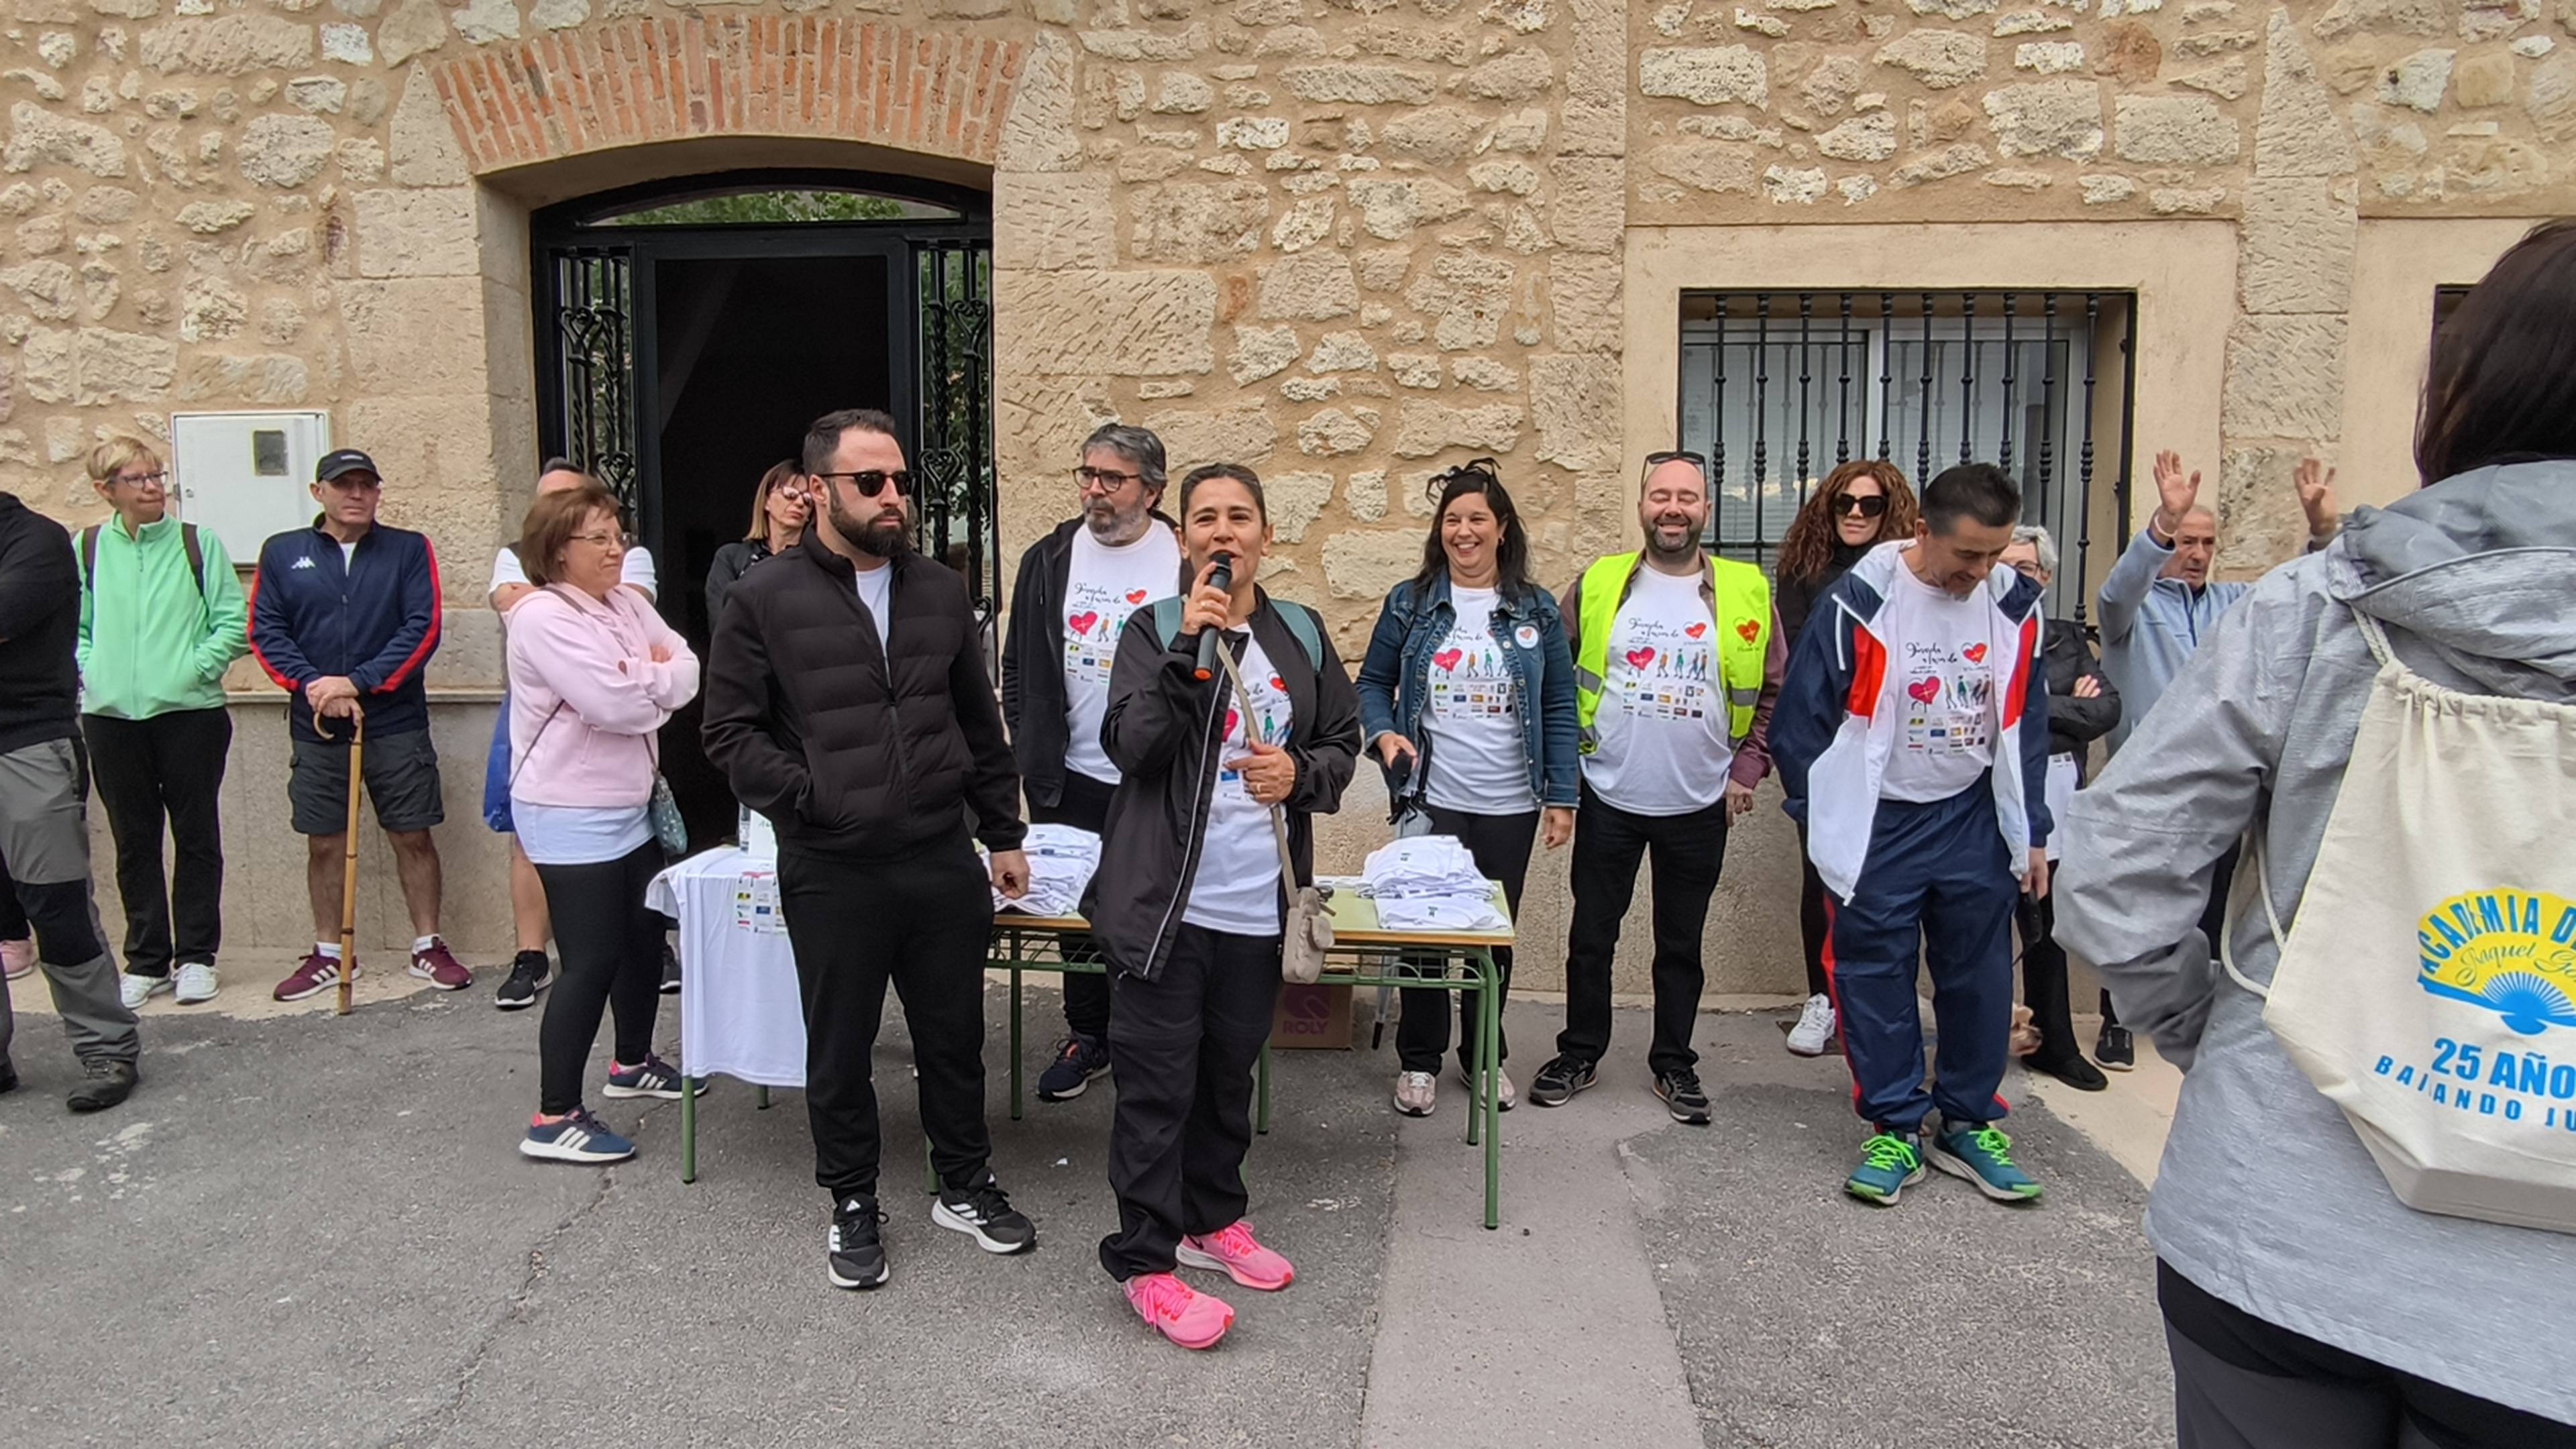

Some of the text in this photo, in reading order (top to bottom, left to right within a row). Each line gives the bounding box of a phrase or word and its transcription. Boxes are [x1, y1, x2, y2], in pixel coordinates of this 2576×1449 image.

[2550, 906, 2576, 951] D
[1283, 1020, 1328, 1034] ROLY
[2430, 1038, 2481, 1081] 25
[2374, 1055, 2522, 1121] BAIANDO
